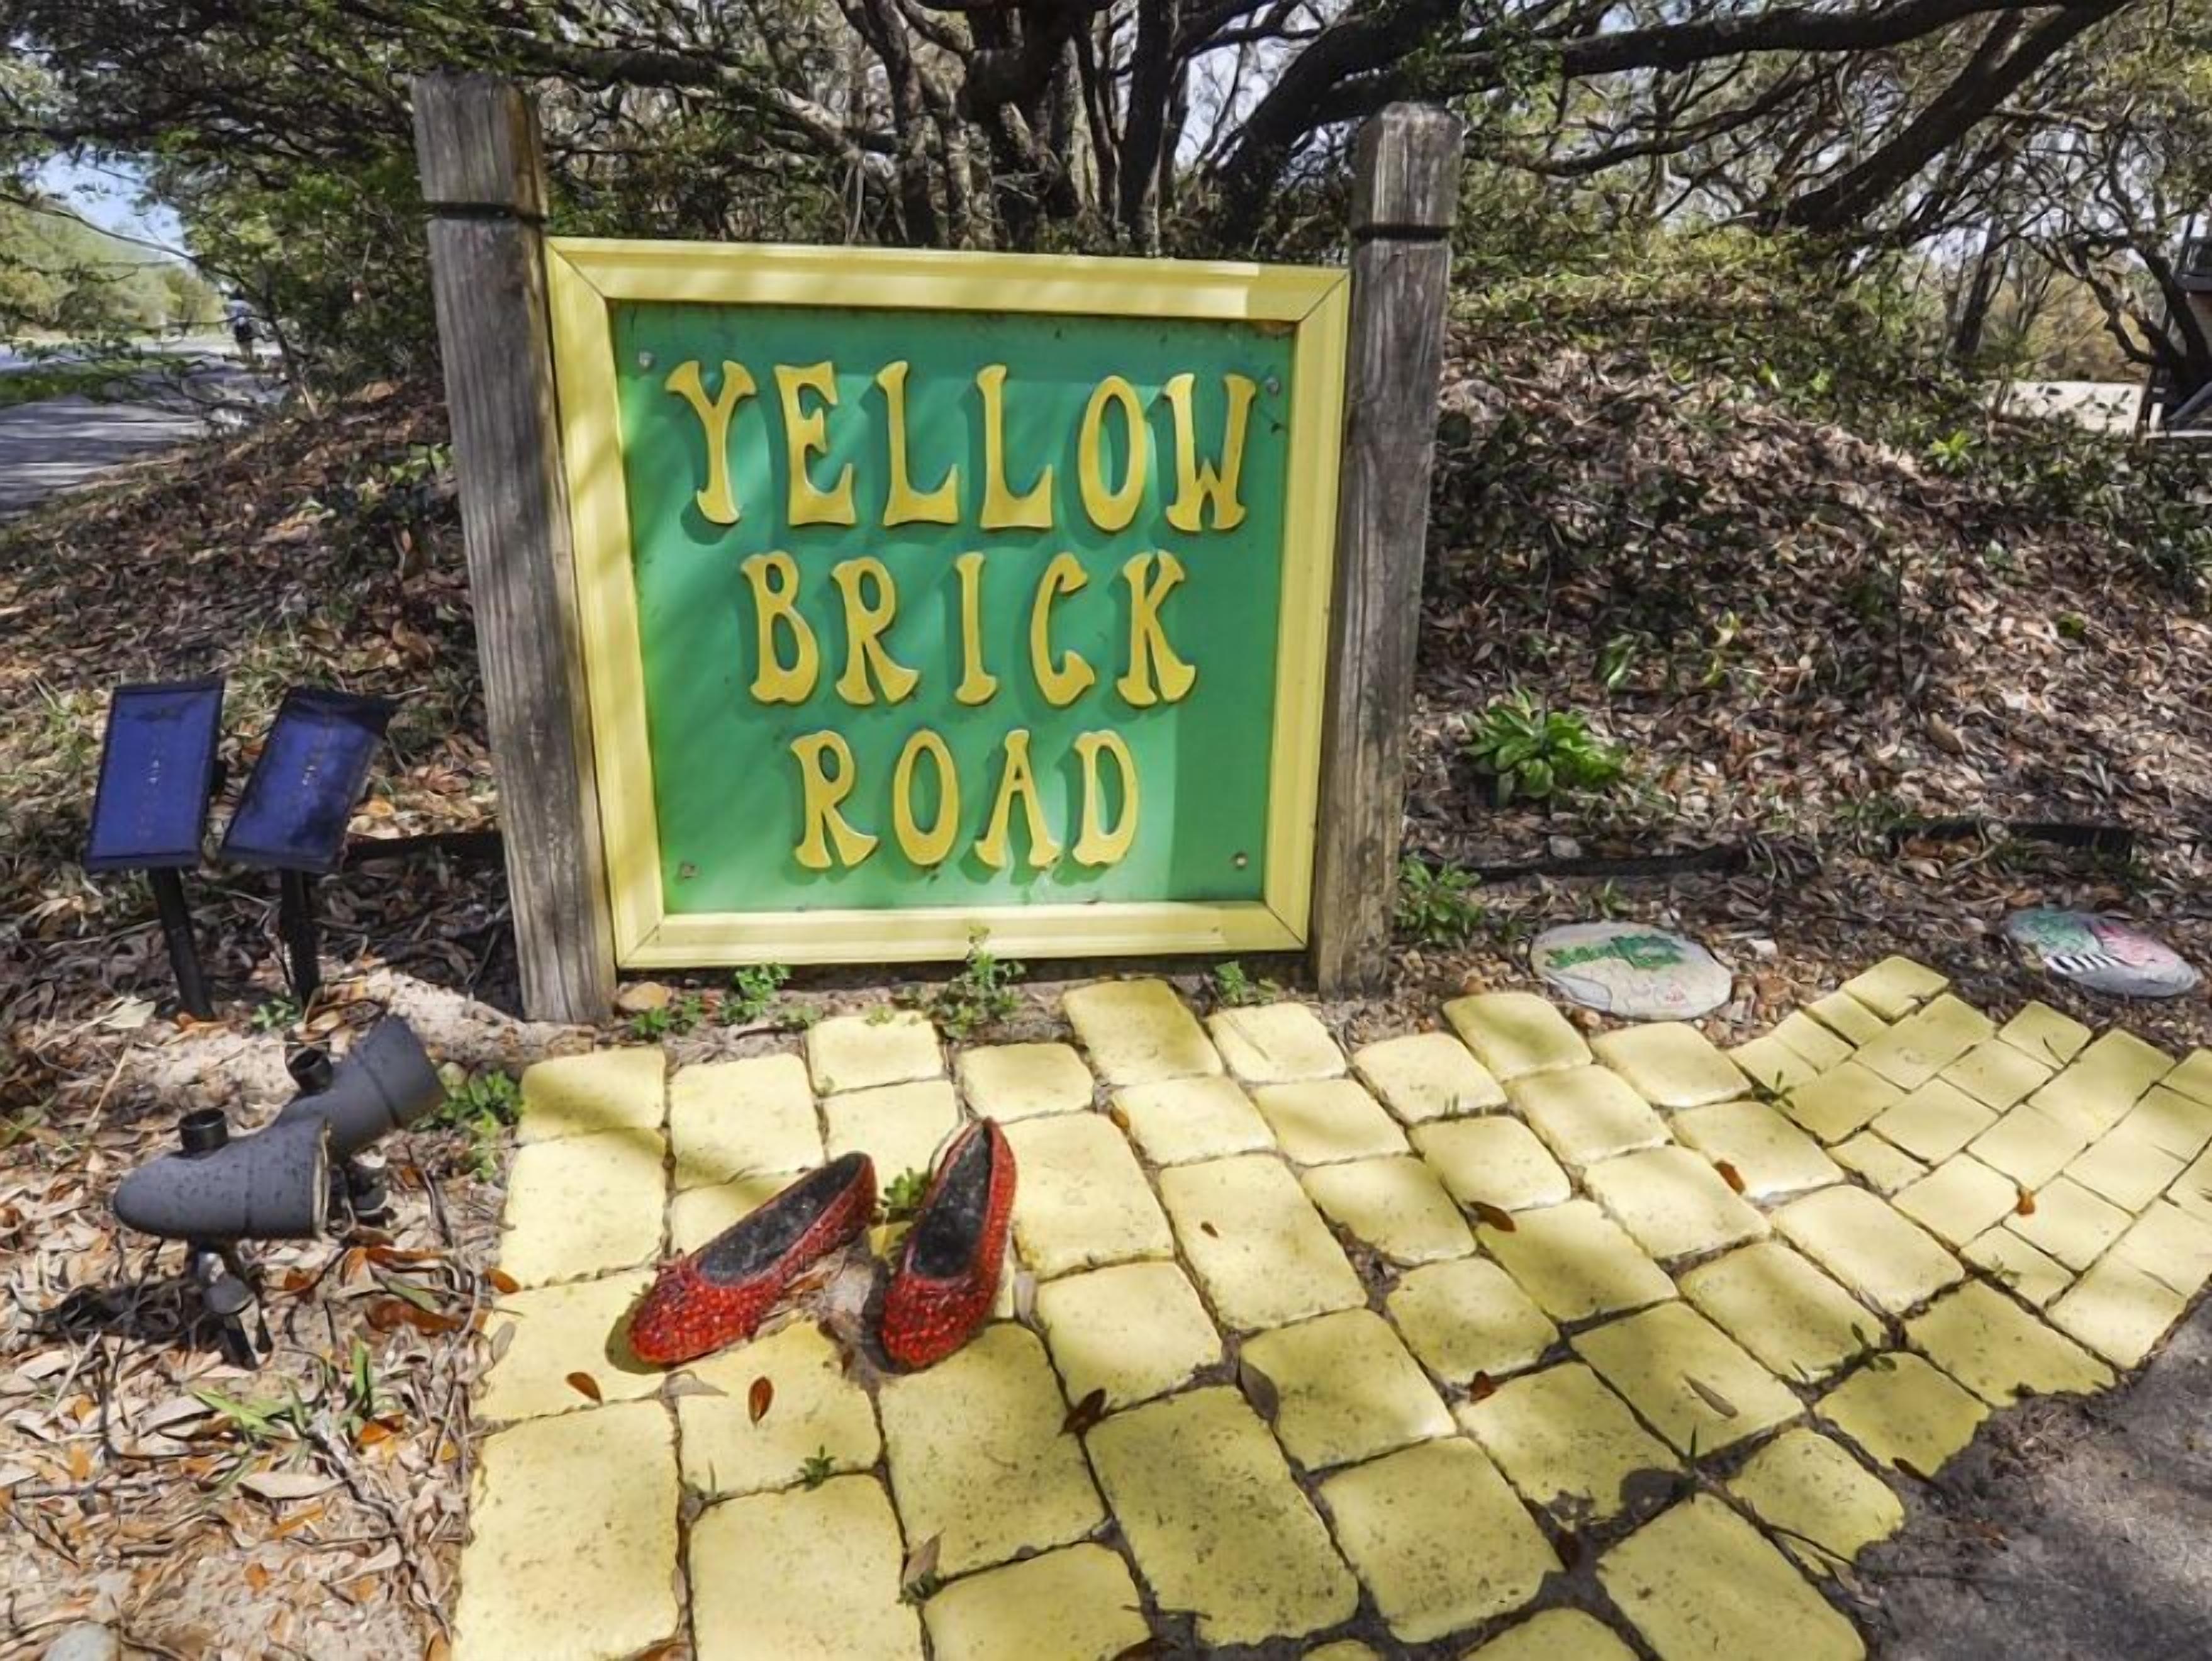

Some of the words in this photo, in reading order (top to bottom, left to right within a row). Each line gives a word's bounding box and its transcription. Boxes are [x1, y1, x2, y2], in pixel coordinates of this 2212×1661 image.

[666, 360, 1256, 532] YELLOW
[740, 549, 1197, 708] BRICK
[790, 728, 1139, 869] ROAD
